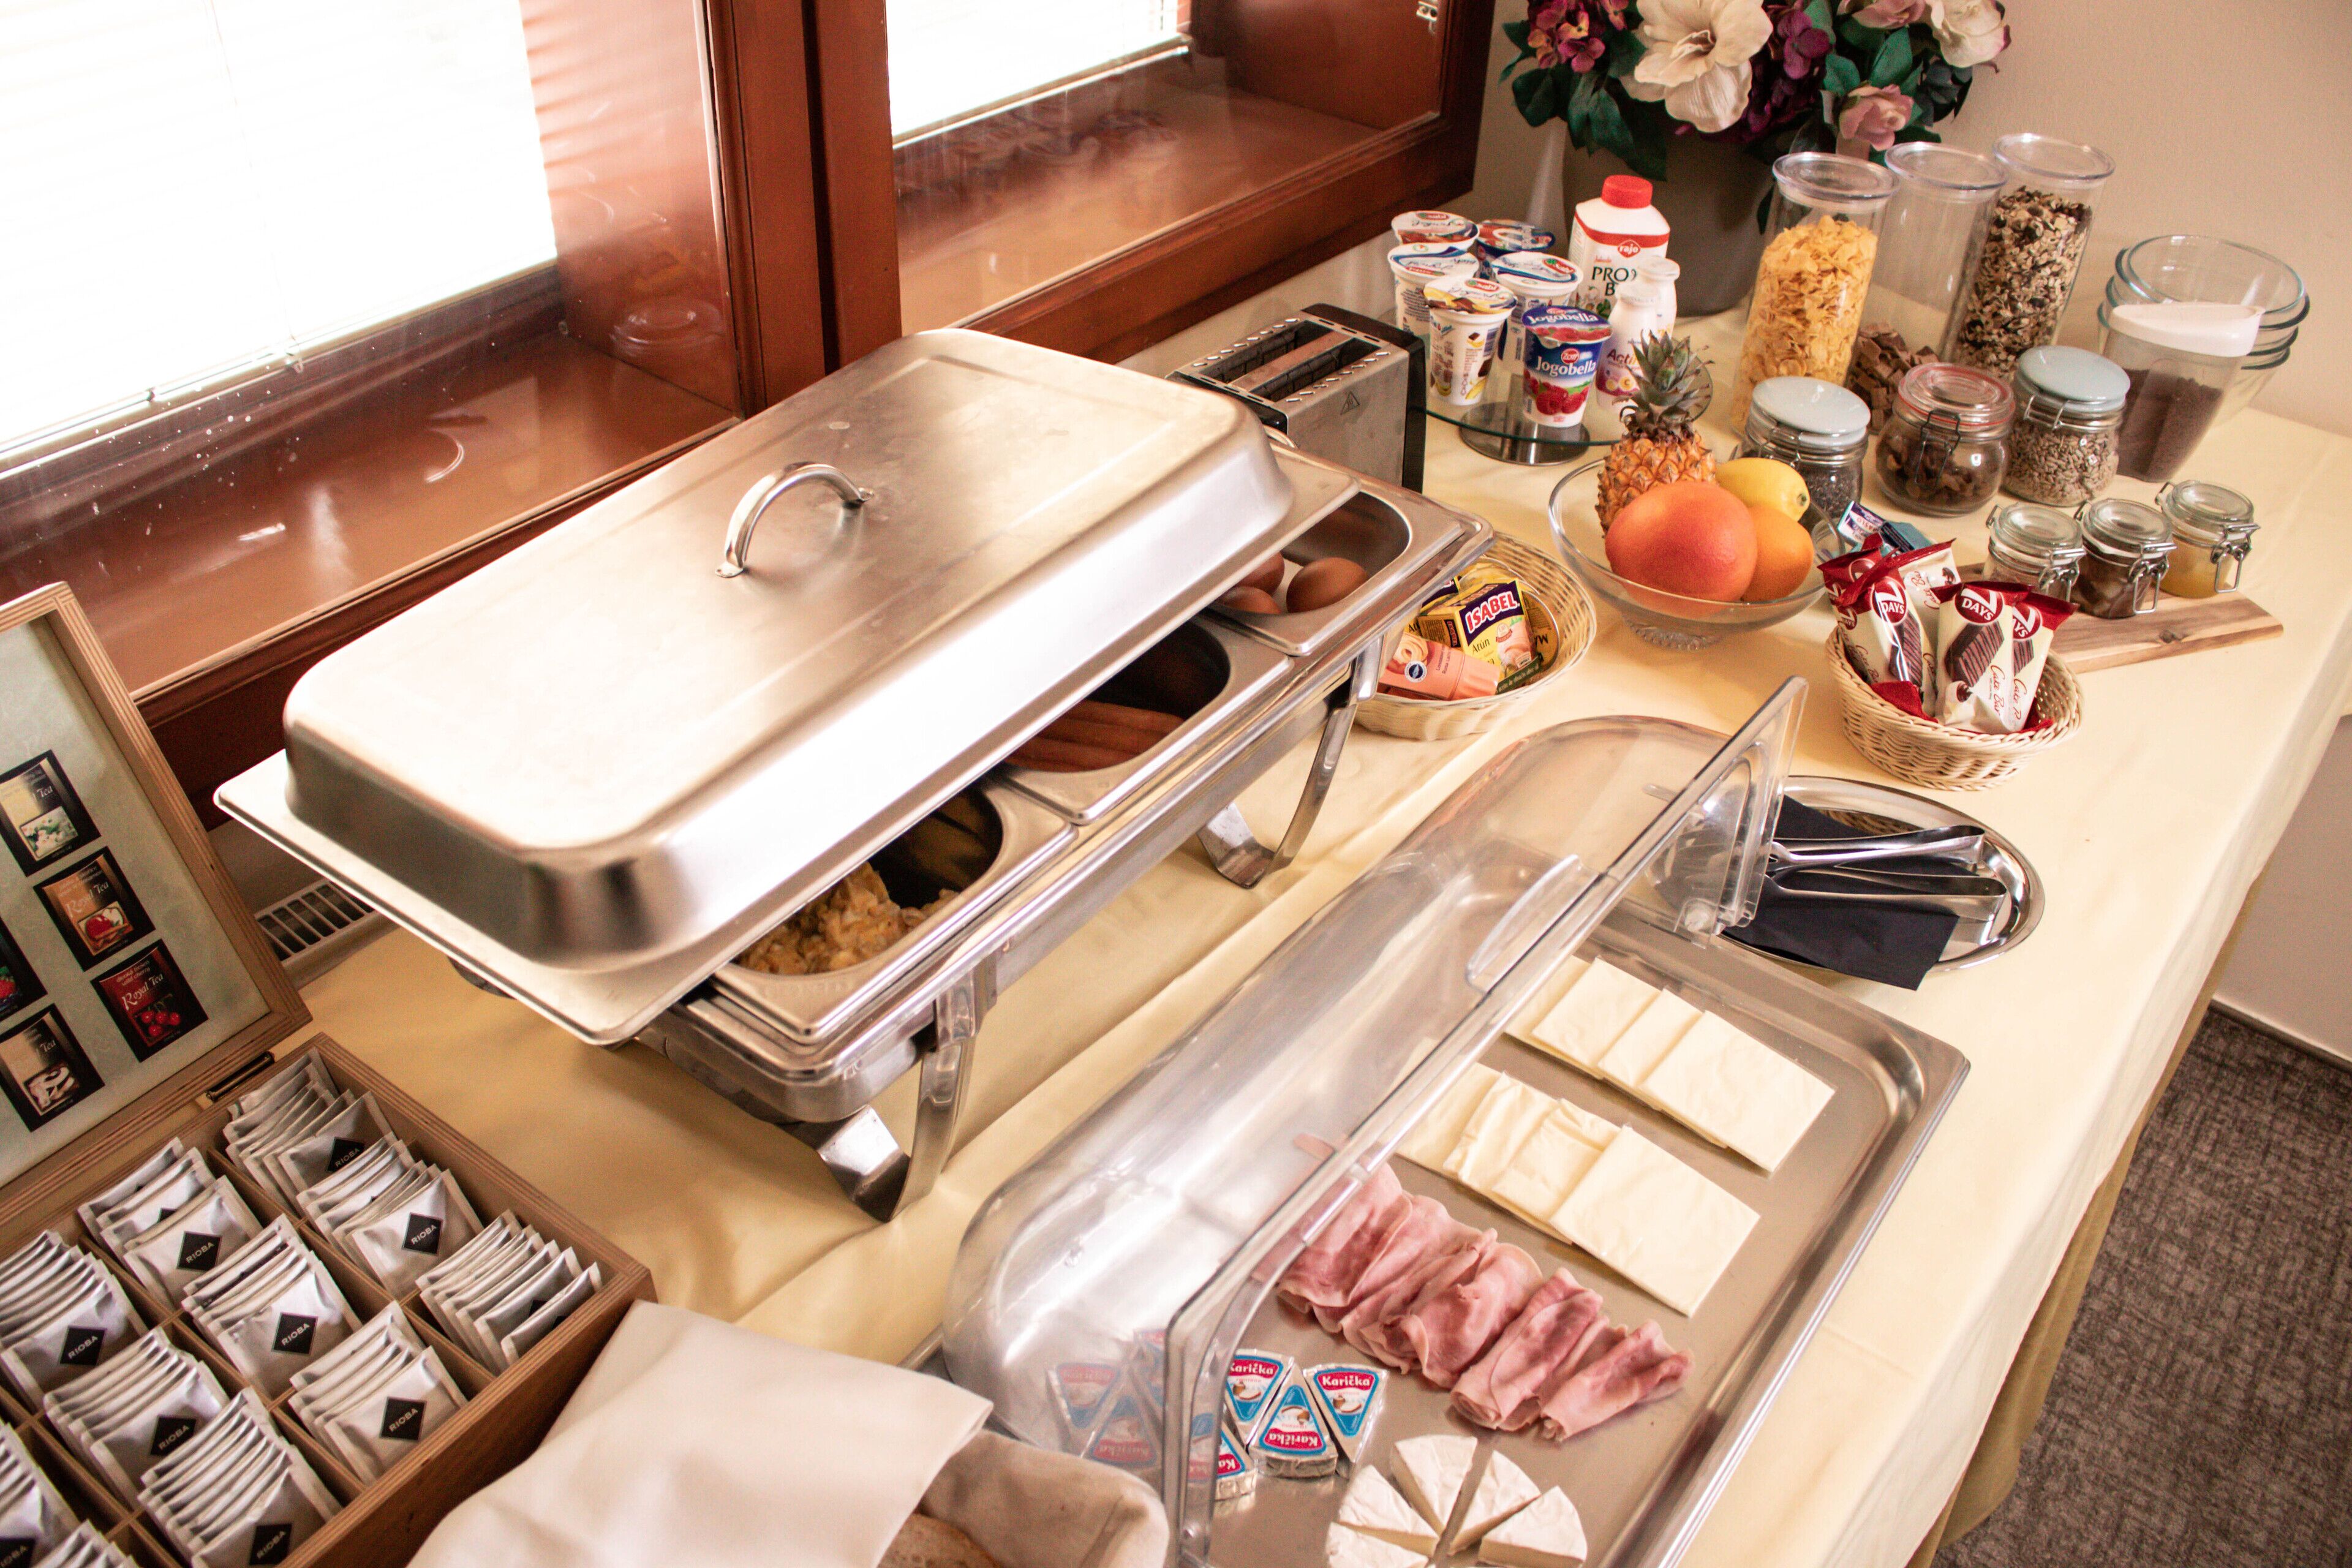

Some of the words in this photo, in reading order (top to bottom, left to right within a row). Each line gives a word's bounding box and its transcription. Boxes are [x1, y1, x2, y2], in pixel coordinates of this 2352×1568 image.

[1619, 244, 1639, 255] rajo
[1527, 312, 1599, 324] Jogobella
[1536, 355, 1597, 377] Jogobella
[1464, 590, 1518, 635] ISABEL
[1881, 601, 1905, 615] DAYS
[1961, 598, 1994, 621] DAYS
[2013, 617, 2029, 638] YS
[1472, 638, 1491, 654] Atún
[1990, 665, 2006, 692] Cake
[37, 785, 53, 797] Tea
[94, 881, 109, 894] Tea
[122, 981, 150, 1011] Royal
[149, 973, 164, 986] Tea
[40, 1039, 56, 1052] Tea
[335, 1147, 360, 1168] RIOBA
[412, 1223, 437, 1246] RIOBA
[186, 1241, 215, 1264] RIOBA
[281, 1321, 311, 1347] RIOBA
[67, 1334, 99, 1360] RIOBA
[1322, 1375, 1371, 1387] Karička
[388, 1406, 418, 1433] RIOBA
[158, 1424, 190, 1452] RIOBA
[1268, 1432, 1318, 1447] Karička
[0, 1544, 28, 1568] IOBA
[257, 1531, 286, 1559] RIOBA
